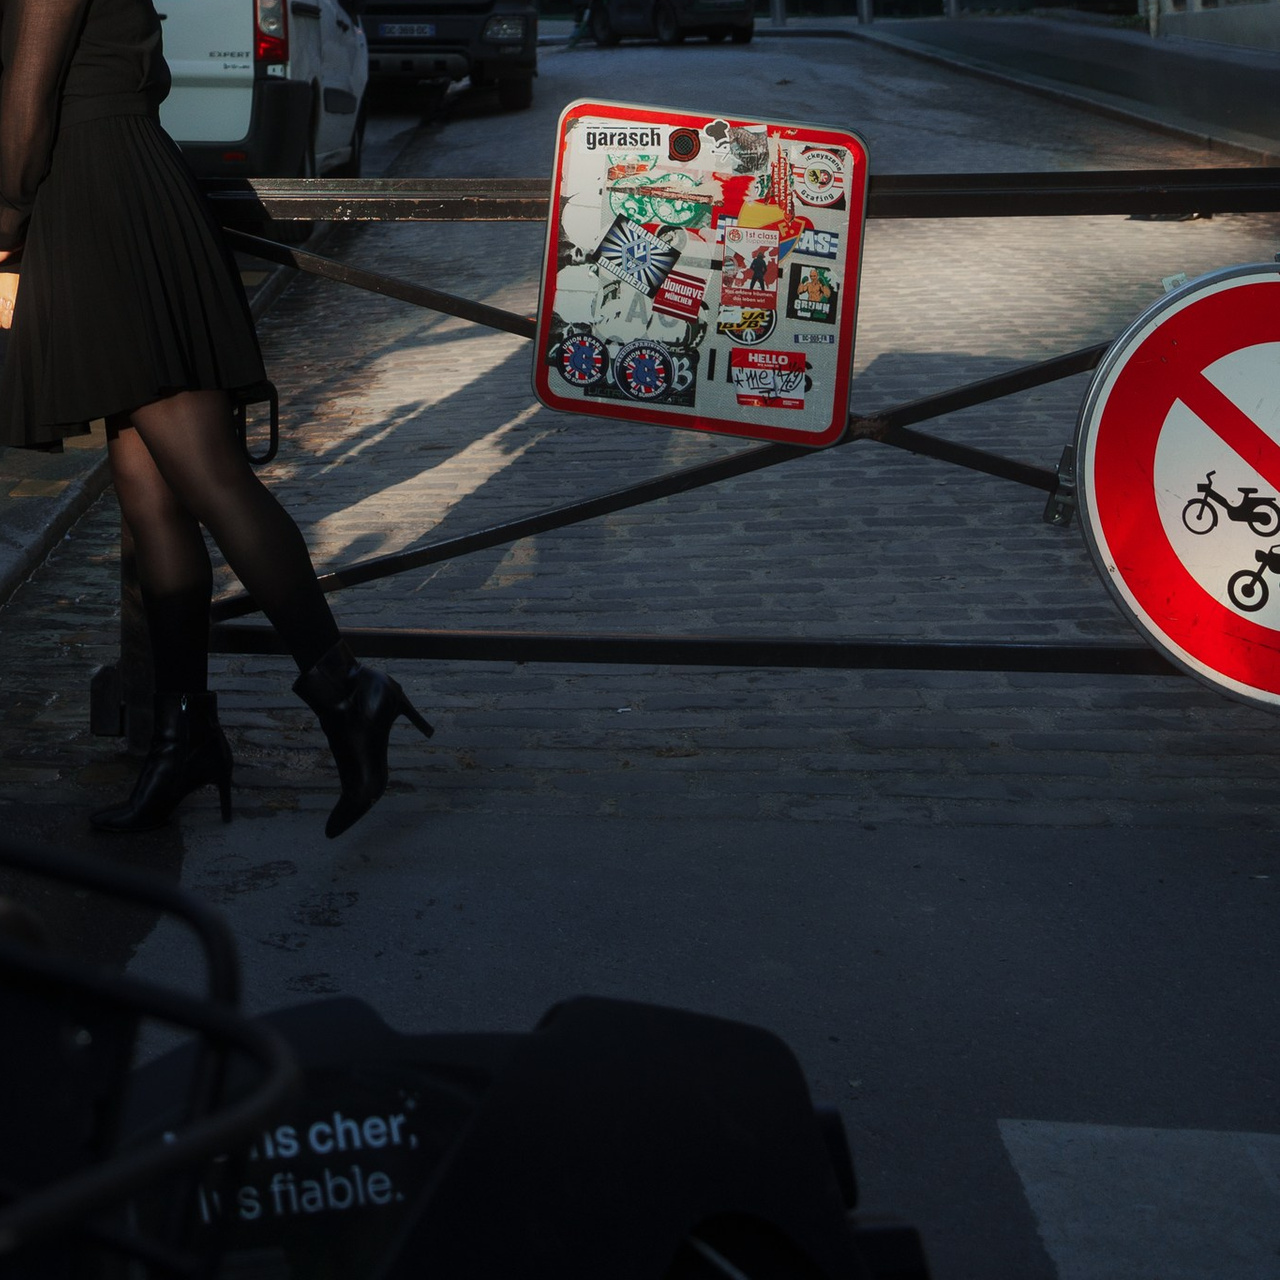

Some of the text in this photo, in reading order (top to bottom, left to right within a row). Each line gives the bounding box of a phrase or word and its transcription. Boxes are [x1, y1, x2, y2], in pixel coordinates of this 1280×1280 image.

[586, 128, 661, 150] garasch
[801, 189, 834, 202] Grafing
[757, 232, 777, 240] class
[597, 256, 651, 294] MANNHEIM
[664, 292, 693, 306] MÜNCHEN
[721, 320, 759, 329] BVB
[562, 336, 603, 352] UNION BEARS
[623, 350, 641, 367] UNION
[641, 349, 664, 361] BEARS
[748, 352, 789, 365] HELLO
[564, 372, 602, 384] NO SURRENDER
[629, 382, 668, 398] NO SURRENDER
[308, 1108, 419, 1160] cher,
[270, 1164, 406, 1217] fiable.
